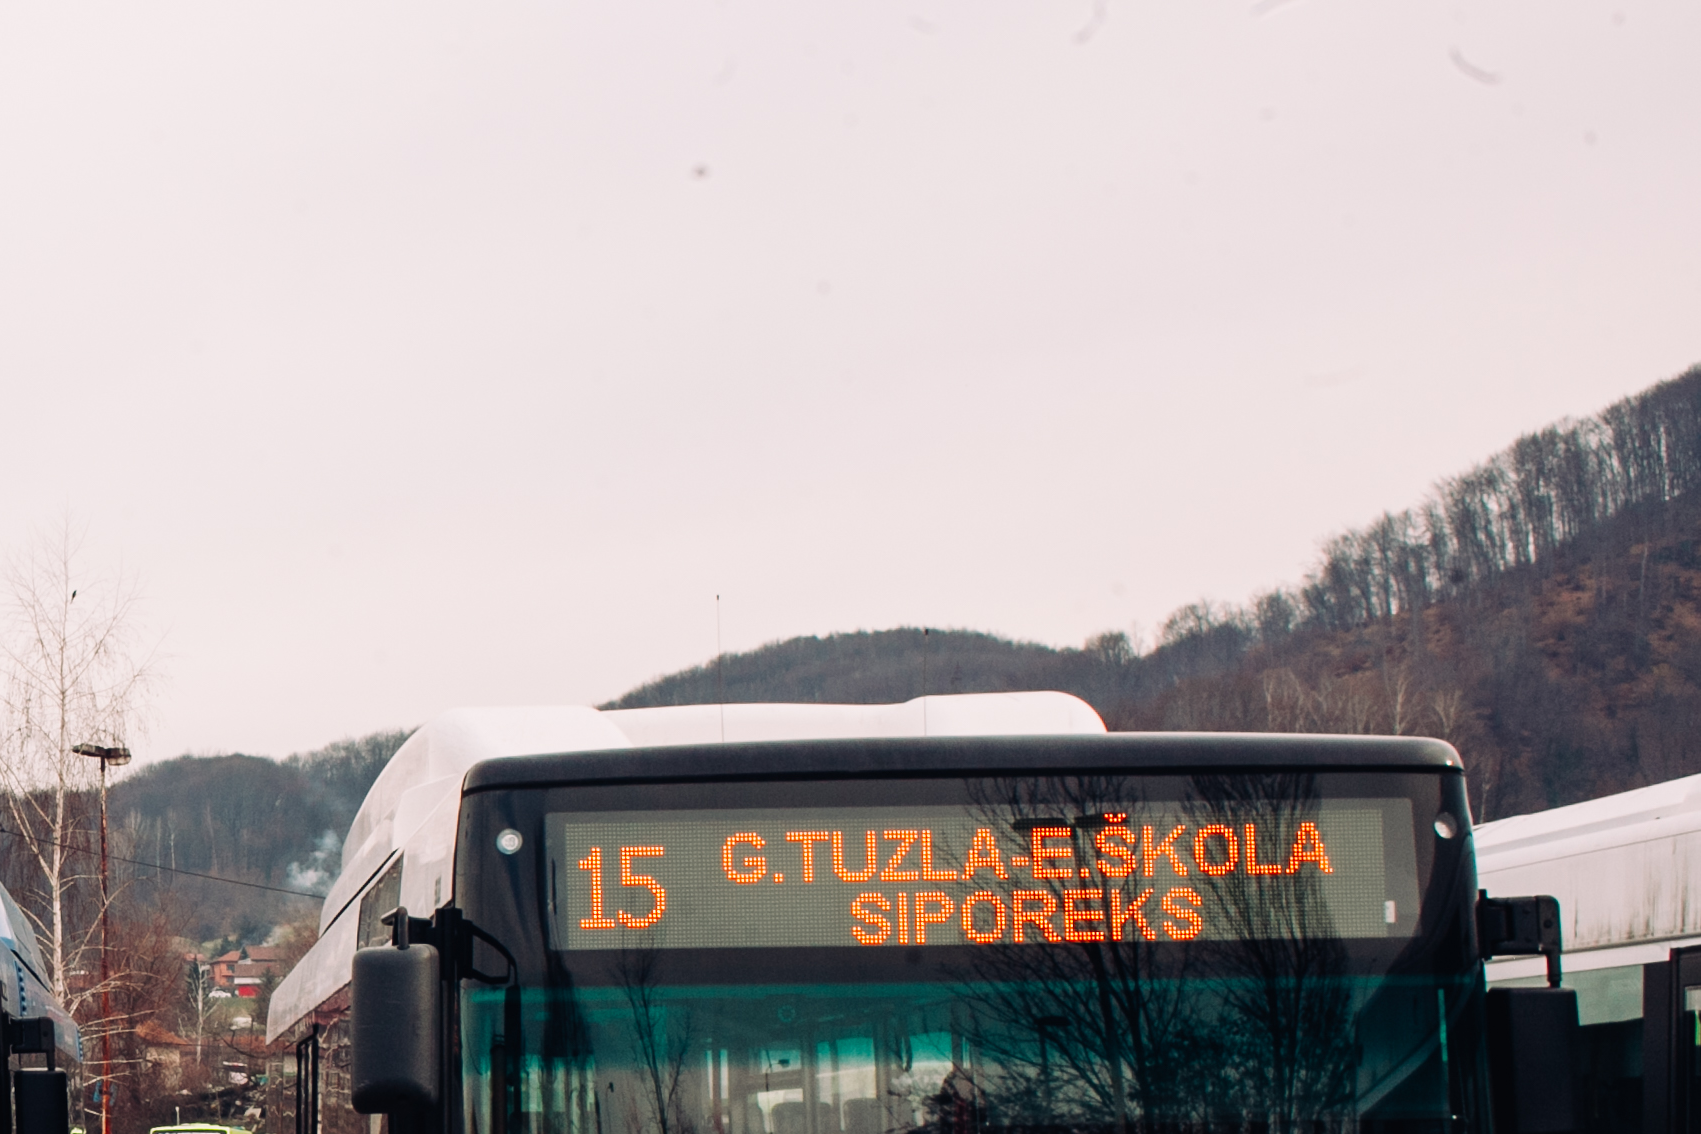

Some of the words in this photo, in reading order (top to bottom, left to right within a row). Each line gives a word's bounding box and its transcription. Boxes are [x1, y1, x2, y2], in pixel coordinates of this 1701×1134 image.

[722, 813, 1334, 884] G.TUZLA-E.ŠKOLA
[578, 845, 666, 930] 15
[850, 887, 1203, 946] SIPOREKS
